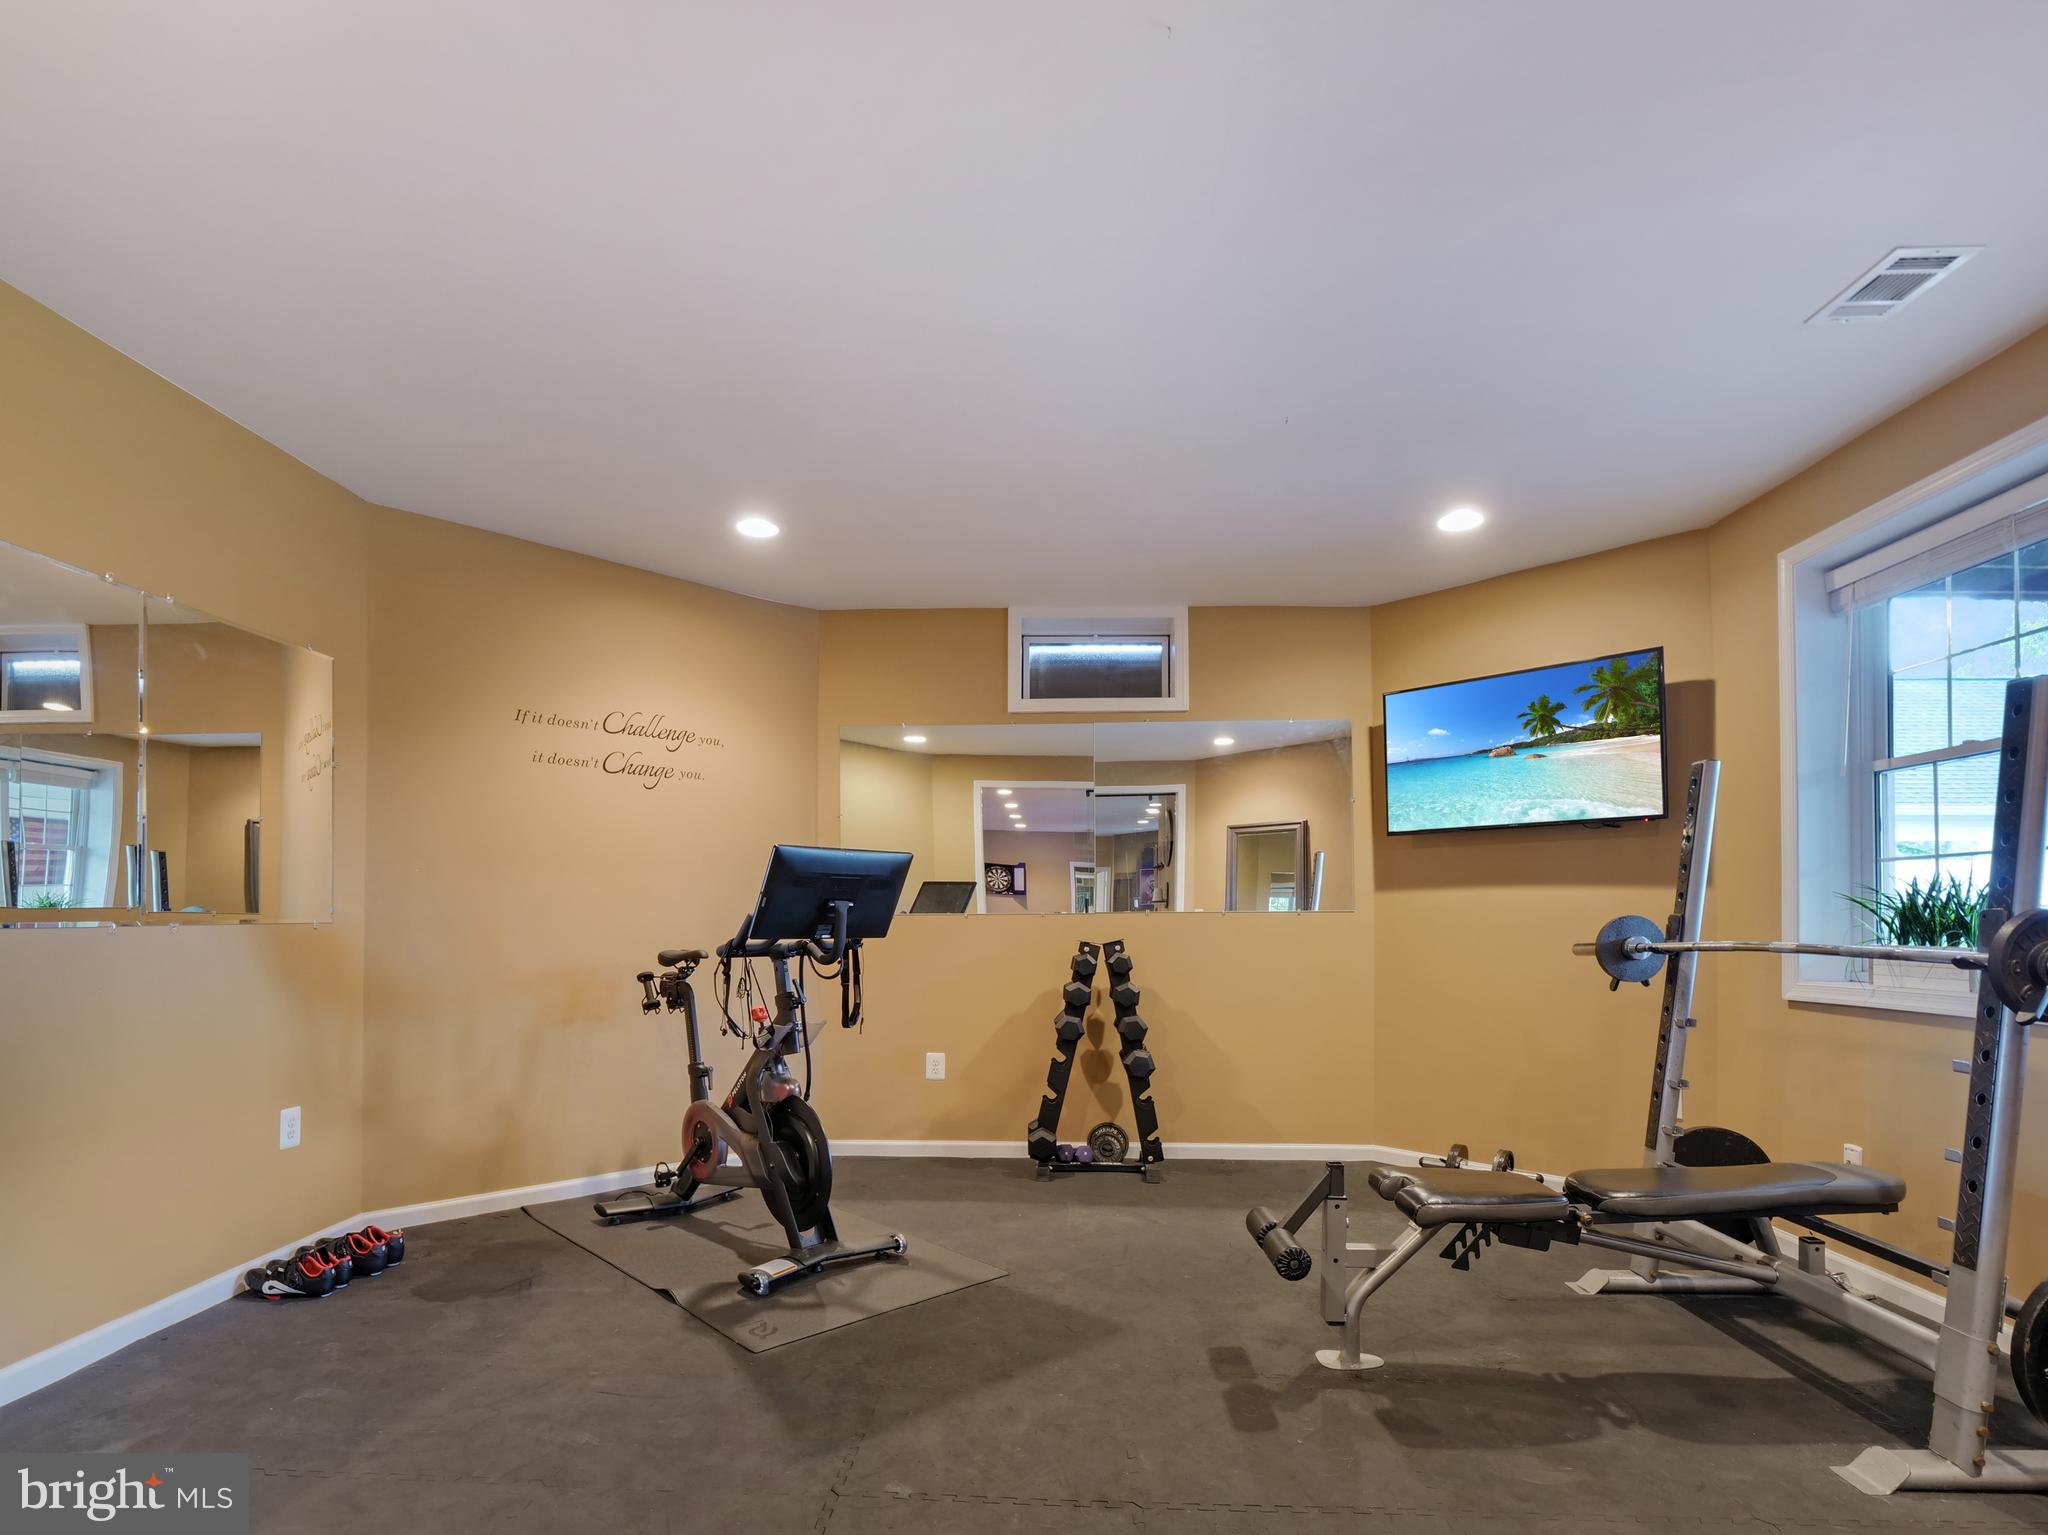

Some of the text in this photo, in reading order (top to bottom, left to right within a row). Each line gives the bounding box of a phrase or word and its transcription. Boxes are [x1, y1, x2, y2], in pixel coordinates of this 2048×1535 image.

[514, 708, 530, 725] If
[531, 711, 544, 725] it
[547, 713, 599, 732] doesn't
[602, 711, 697, 753] Challenge
[532, 750, 544, 764] it
[547, 751, 599, 769] doesn't
[602, 751, 675, 790] Change
